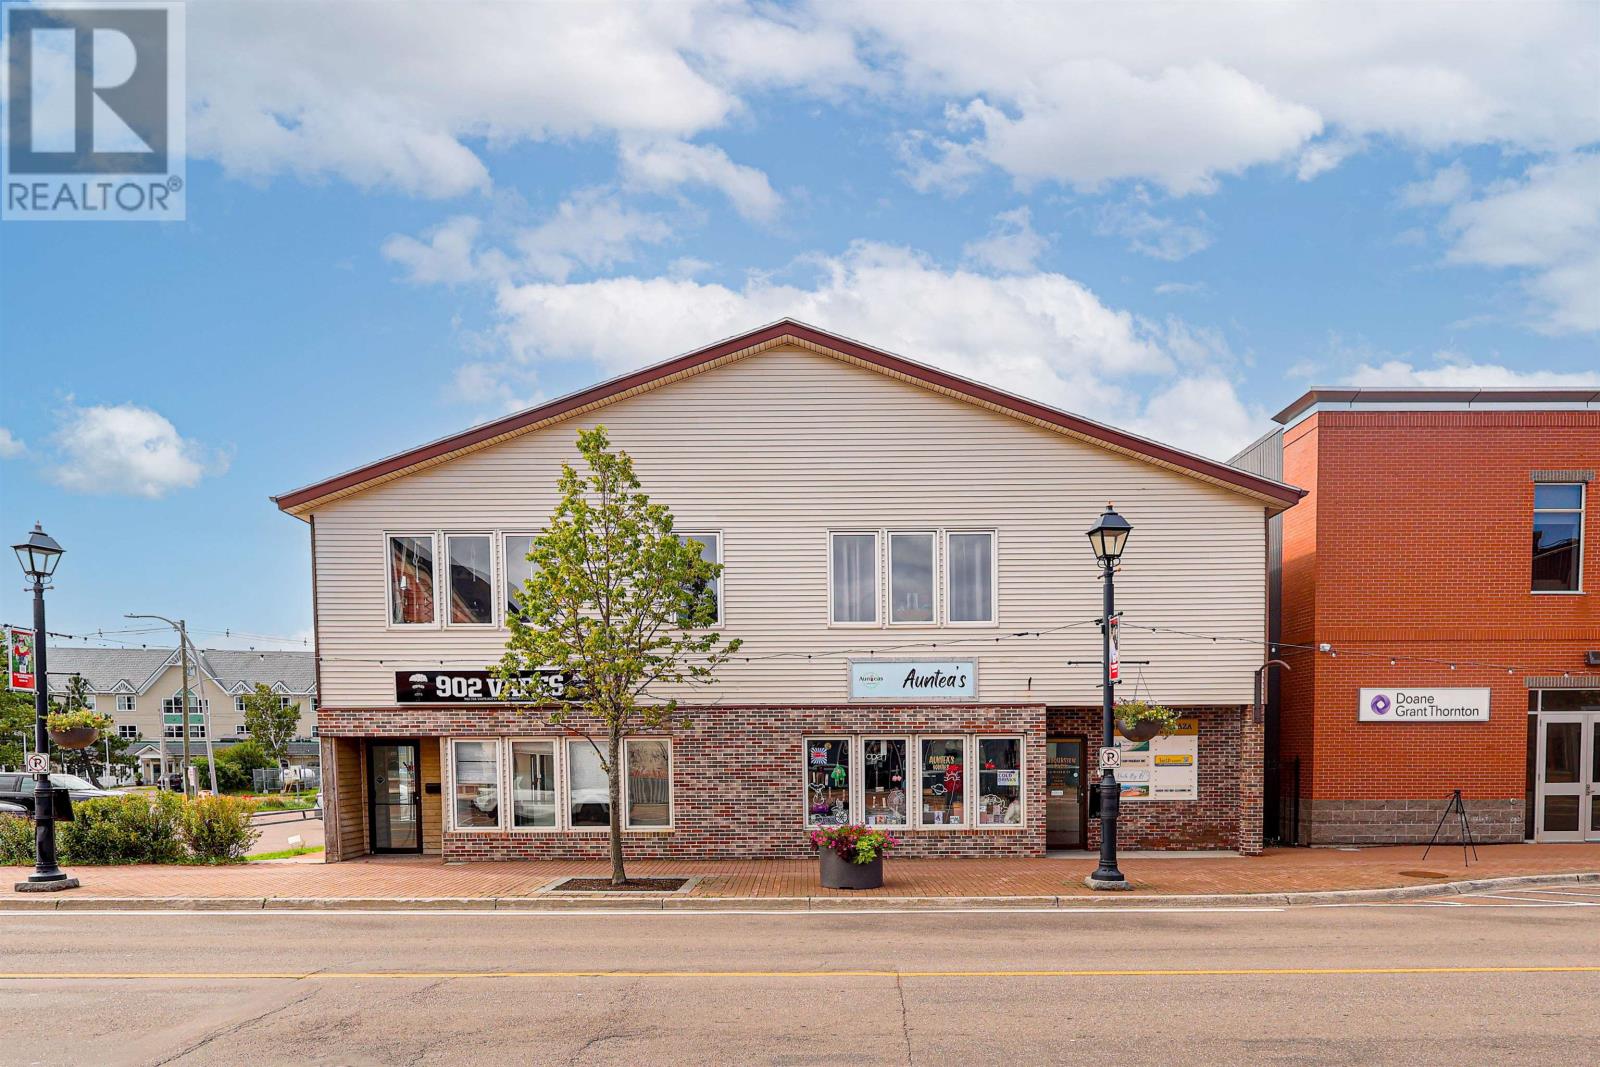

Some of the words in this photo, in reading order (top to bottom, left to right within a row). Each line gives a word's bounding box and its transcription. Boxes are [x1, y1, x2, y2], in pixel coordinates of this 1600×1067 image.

[902, 665, 967, 689] Auntea's
[435, 675, 483, 698] 902
[1396, 692, 1435, 704] Doane
[1395, 705, 1428, 717] Grant
[1428, 705, 1480, 717] Thornton
